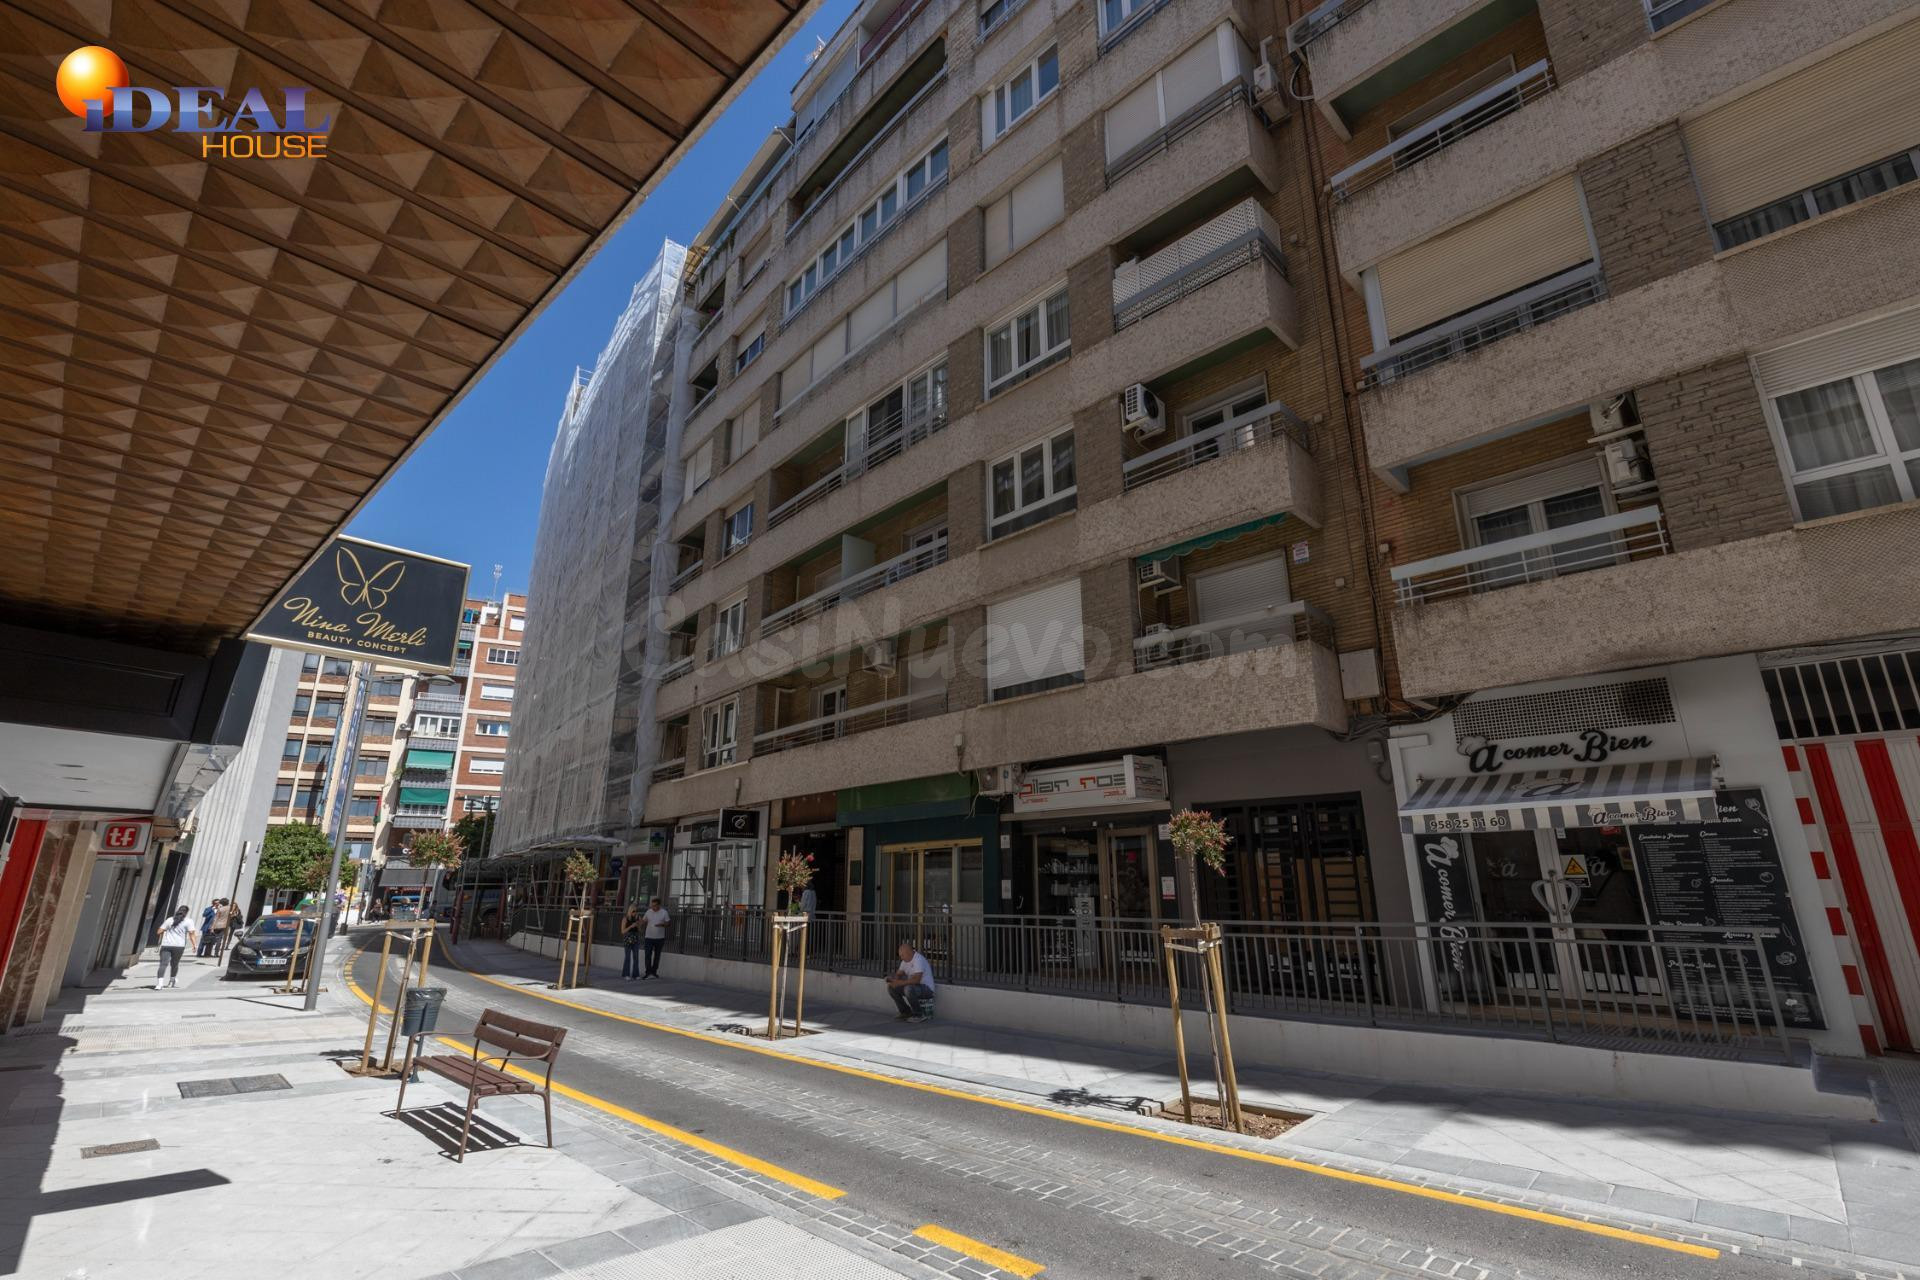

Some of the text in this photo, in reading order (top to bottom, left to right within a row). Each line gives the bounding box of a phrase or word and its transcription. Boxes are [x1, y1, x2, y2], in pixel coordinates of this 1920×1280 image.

[283, 597, 428, 646] Nina Merli
[307, 631, 407, 654] BEAUTY CONCEPT
[1574, 729, 1653, 762] Bien
[1430, 816, 1505, 831] 958 25 11 60
[1642, 806, 1676, 821] Bien
